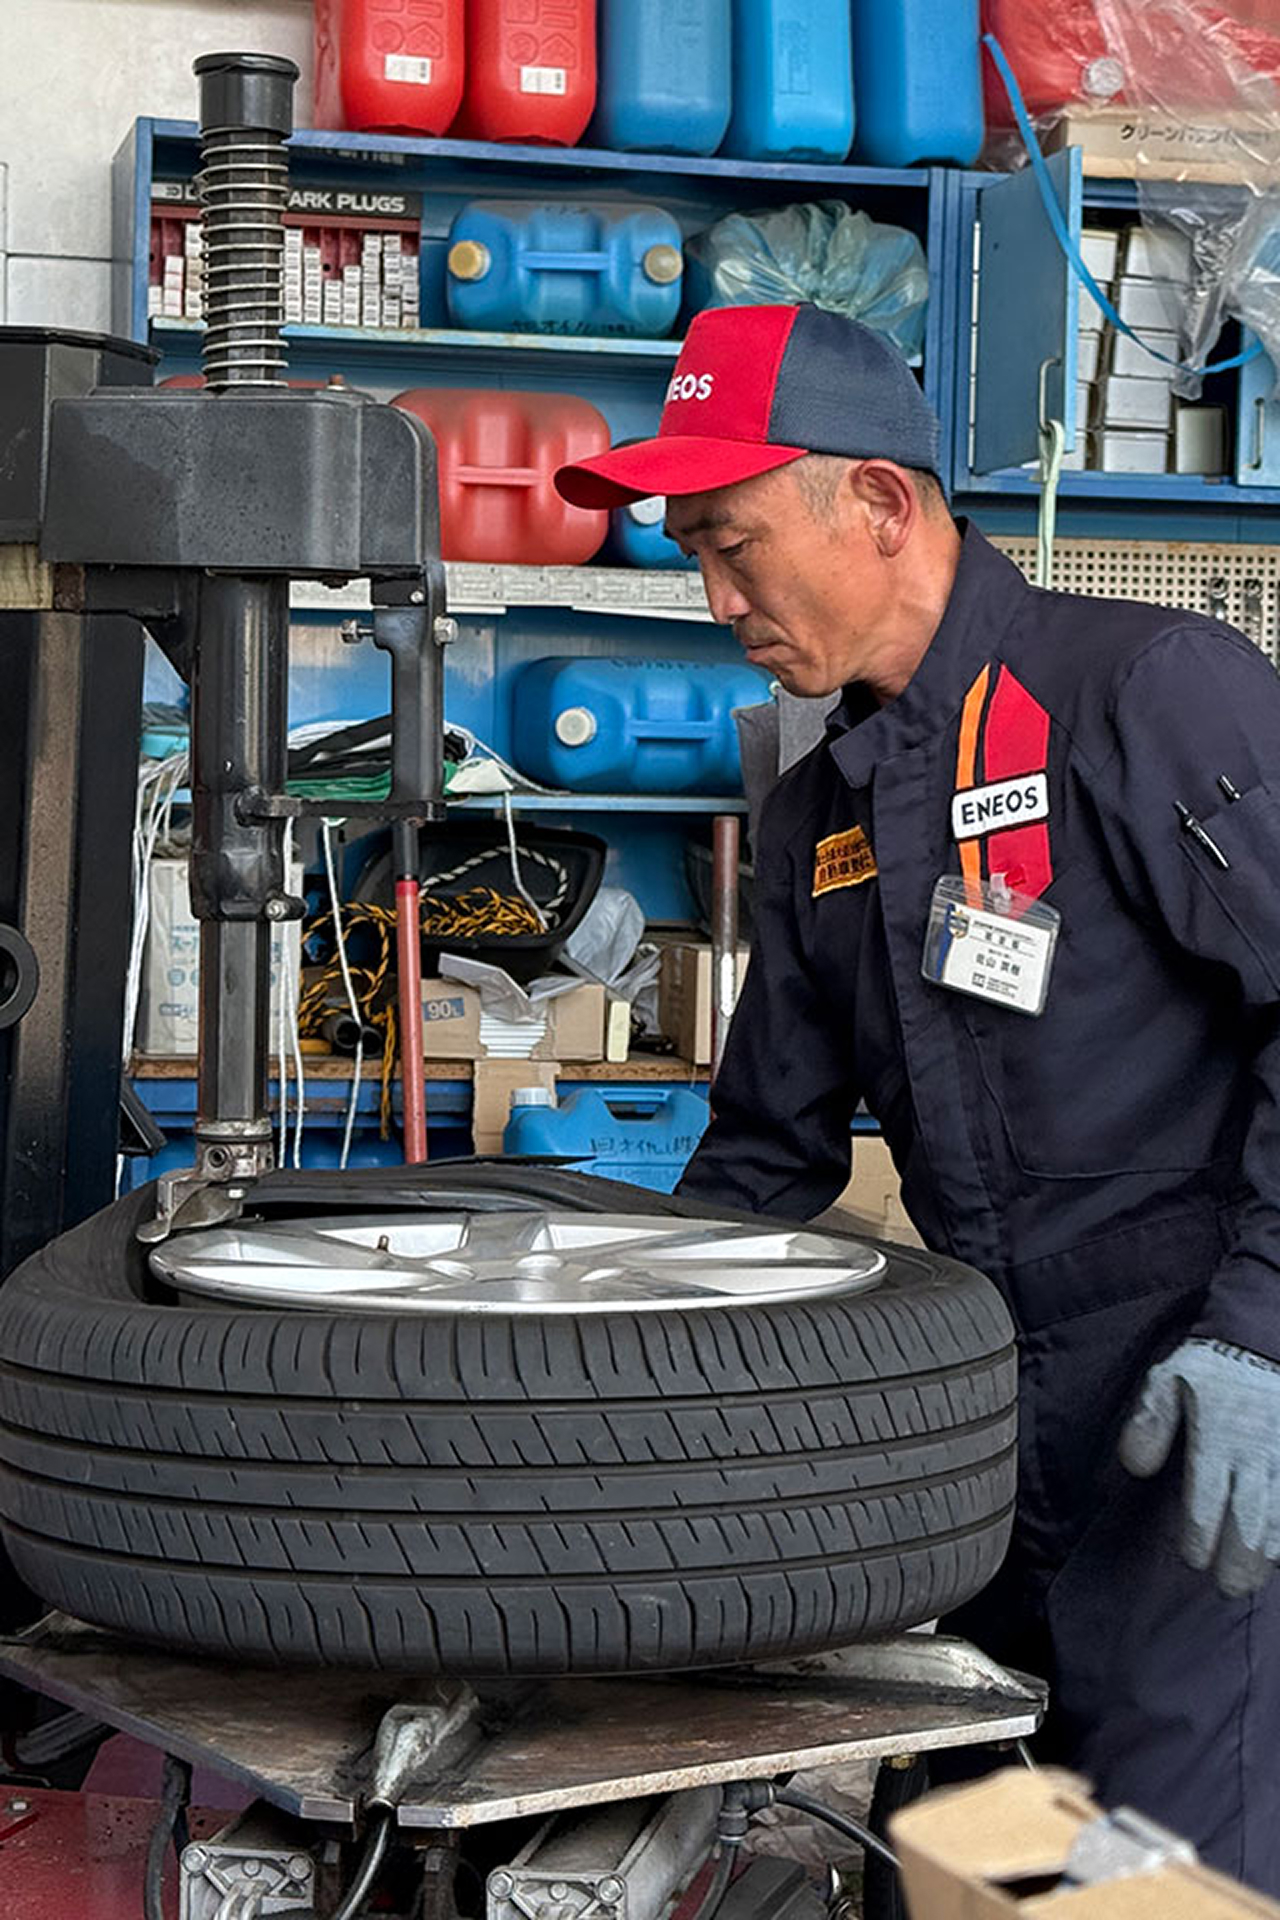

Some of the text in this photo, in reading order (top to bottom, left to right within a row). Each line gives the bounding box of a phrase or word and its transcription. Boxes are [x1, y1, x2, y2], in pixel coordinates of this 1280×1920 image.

[288, 190, 406, 213] ARK PLUGS
[961, 786, 1039, 826] ENEOS
